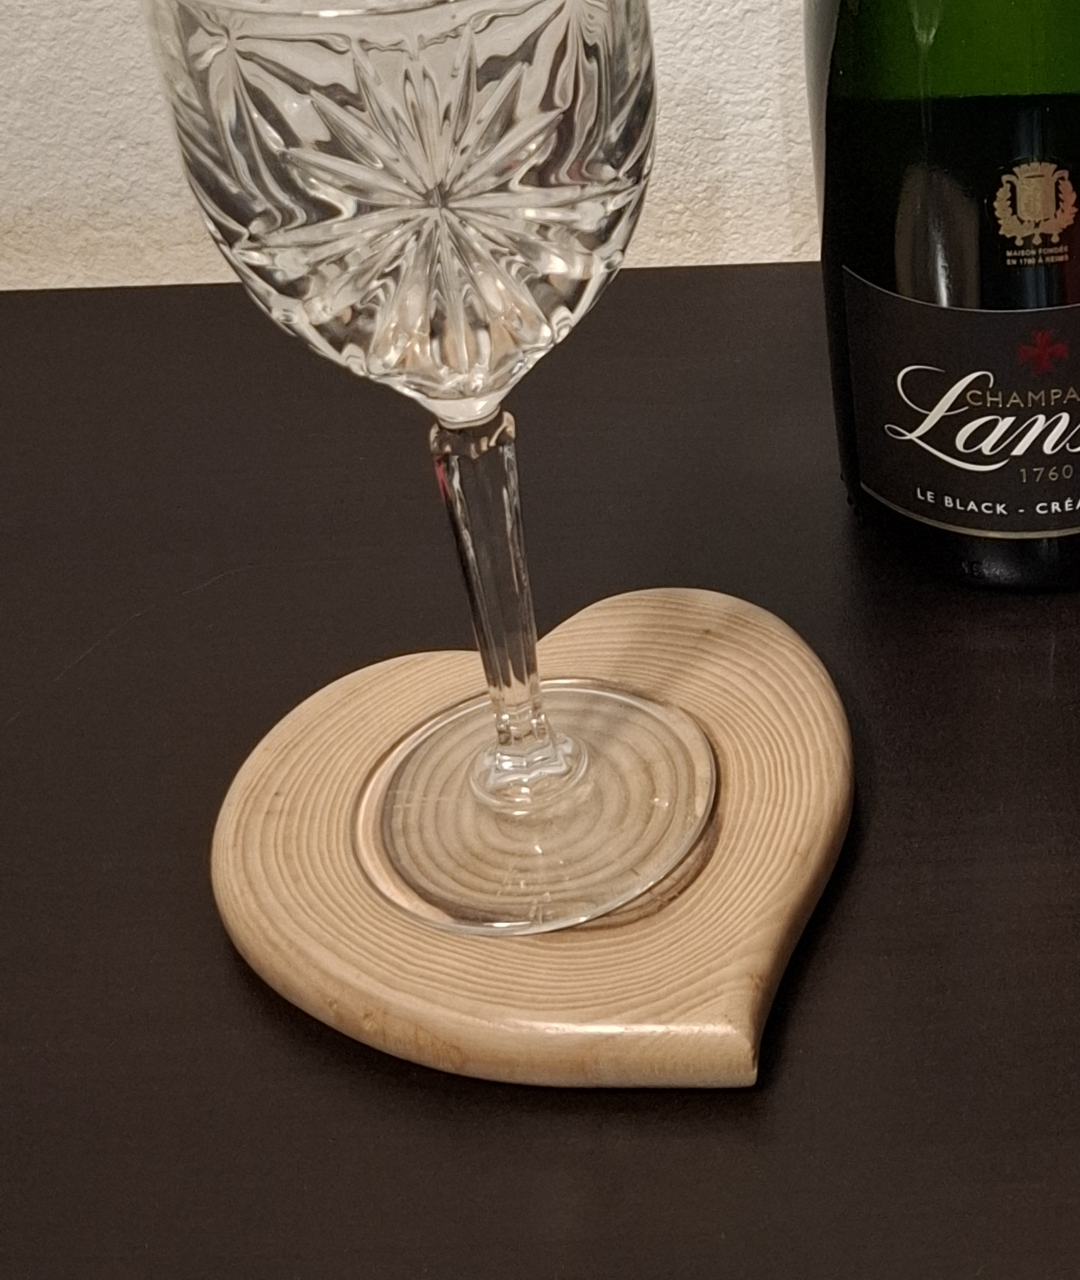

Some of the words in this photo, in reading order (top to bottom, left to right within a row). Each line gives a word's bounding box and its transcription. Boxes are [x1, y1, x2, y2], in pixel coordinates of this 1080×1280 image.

[1006, 249, 1036, 257] MAISON
[1021, 464, 1074, 483] 1760
[917, 487, 936, 503] LE
[944, 496, 1008, 515] BLACK
